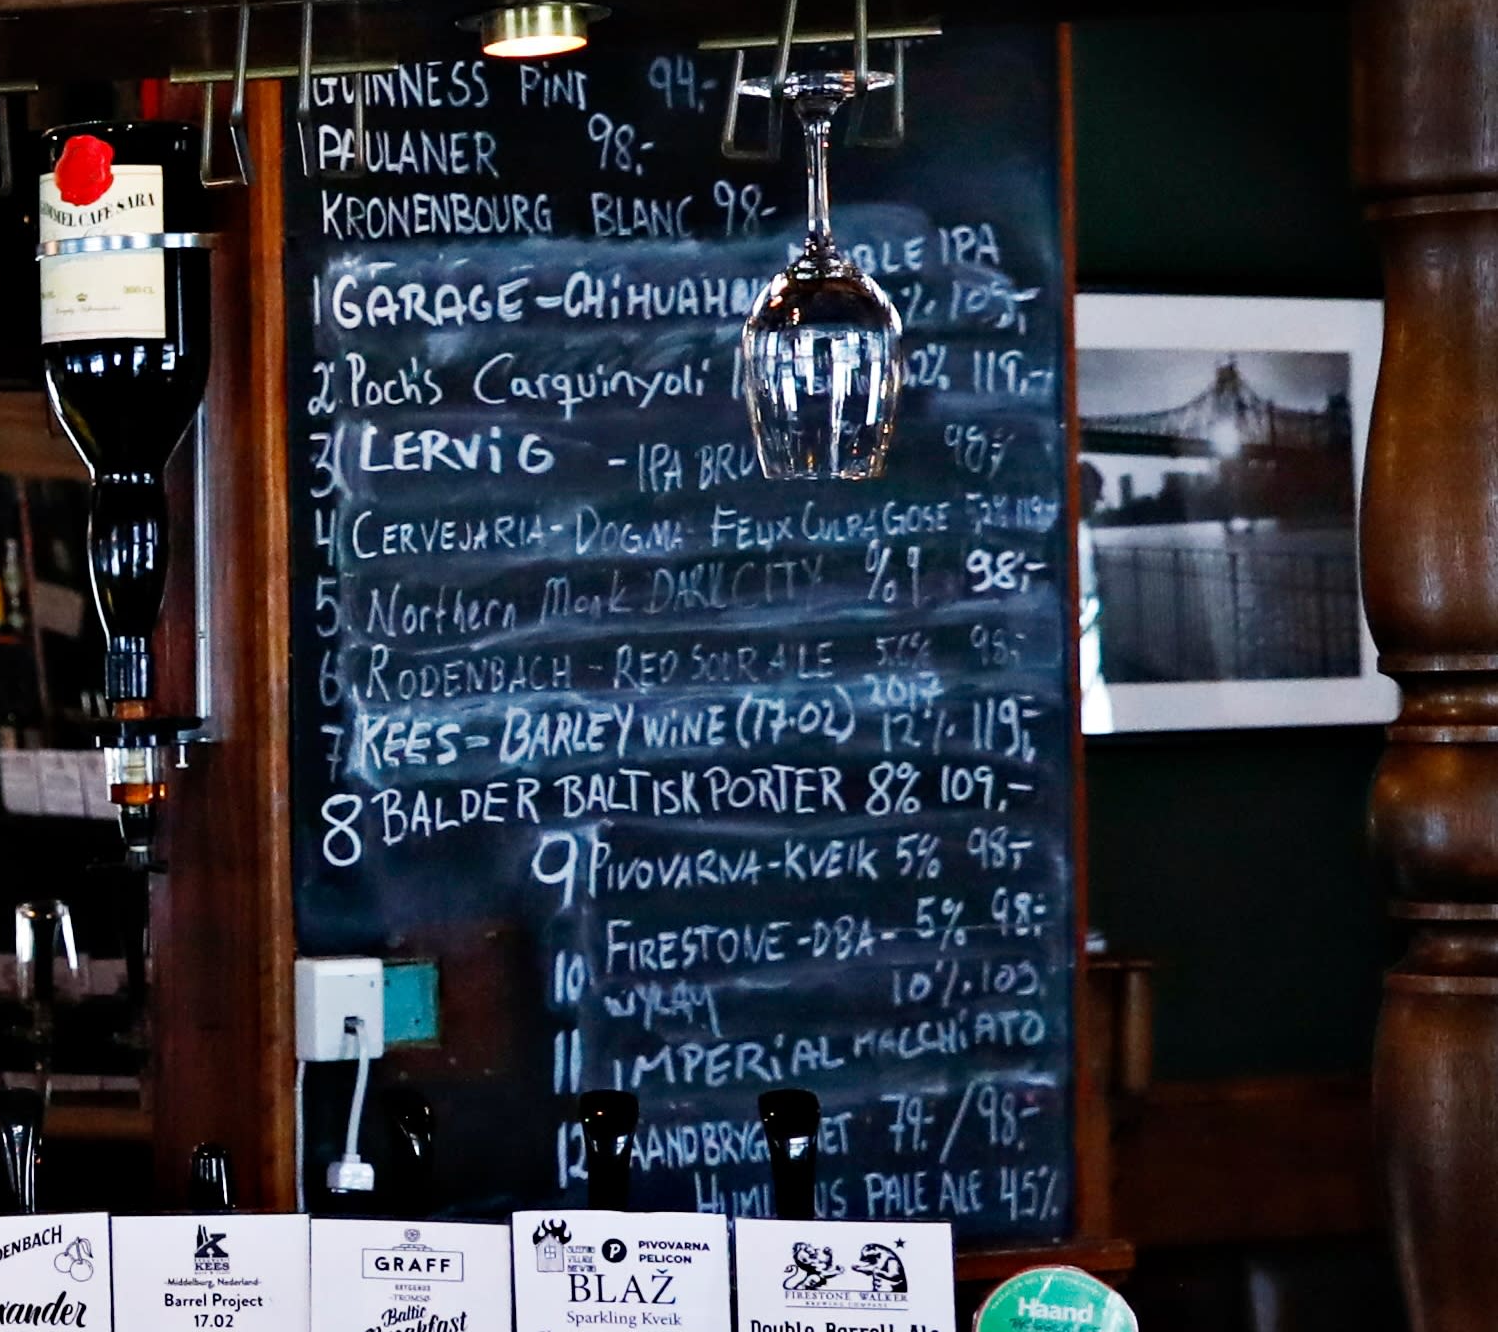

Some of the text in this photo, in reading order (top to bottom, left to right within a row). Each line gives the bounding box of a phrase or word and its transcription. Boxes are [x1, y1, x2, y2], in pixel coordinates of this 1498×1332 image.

[313, 61, 489, 108] GUINNESS
[319, 124, 500, 178] PAULANER
[322, 189, 694, 240] KRONENBOURG BLANC
[939, 222, 1000, 264] IPA
[331, 273, 528, 328] GARAGE
[474, 353, 710, 421] Carquinyoli
[638, 442, 683, 493] IPA
[315, 509, 336, 568] 4
[366, 583, 517, 638] Northern
[366, 643, 571, 702] RODENBACH
[613, 643, 676, 691] RED
[321, 703, 634, 783] 7 BARLEY
[321, 793, 362, 867] 8
[371, 777, 541, 847] BALDER
[554, 768, 701, 818] BALTISK
[703, 763, 847, 814] PORTER
[865, 762, 921, 816] 8%
[532, 830, 579, 909] 9
[606, 920, 792, 975] FIRESTONE
[555, 950, 583, 1002] 10
[865, 1172, 927, 1218] PALE
[195, 1263, 229, 1271] KEES
[375, 1257, 451, 1273] GRAFF
[638, 1240, 710, 1252] PIVOVARNA
[639, 1253, 692, 1265] PELICON
[164, 1294, 263, 1311] Barrel Project
[568, 1269, 676, 1305] BLAŽ
[785, 1290, 908, 1302] FIRESTONE WALKER
[1018, 1297, 1093, 1321] Haand
[194, 1315, 234, 1327] 17.02
[381, 1305, 426, 1328] Baltic
[566, 1311, 682, 1327] Sparkling Kveik
